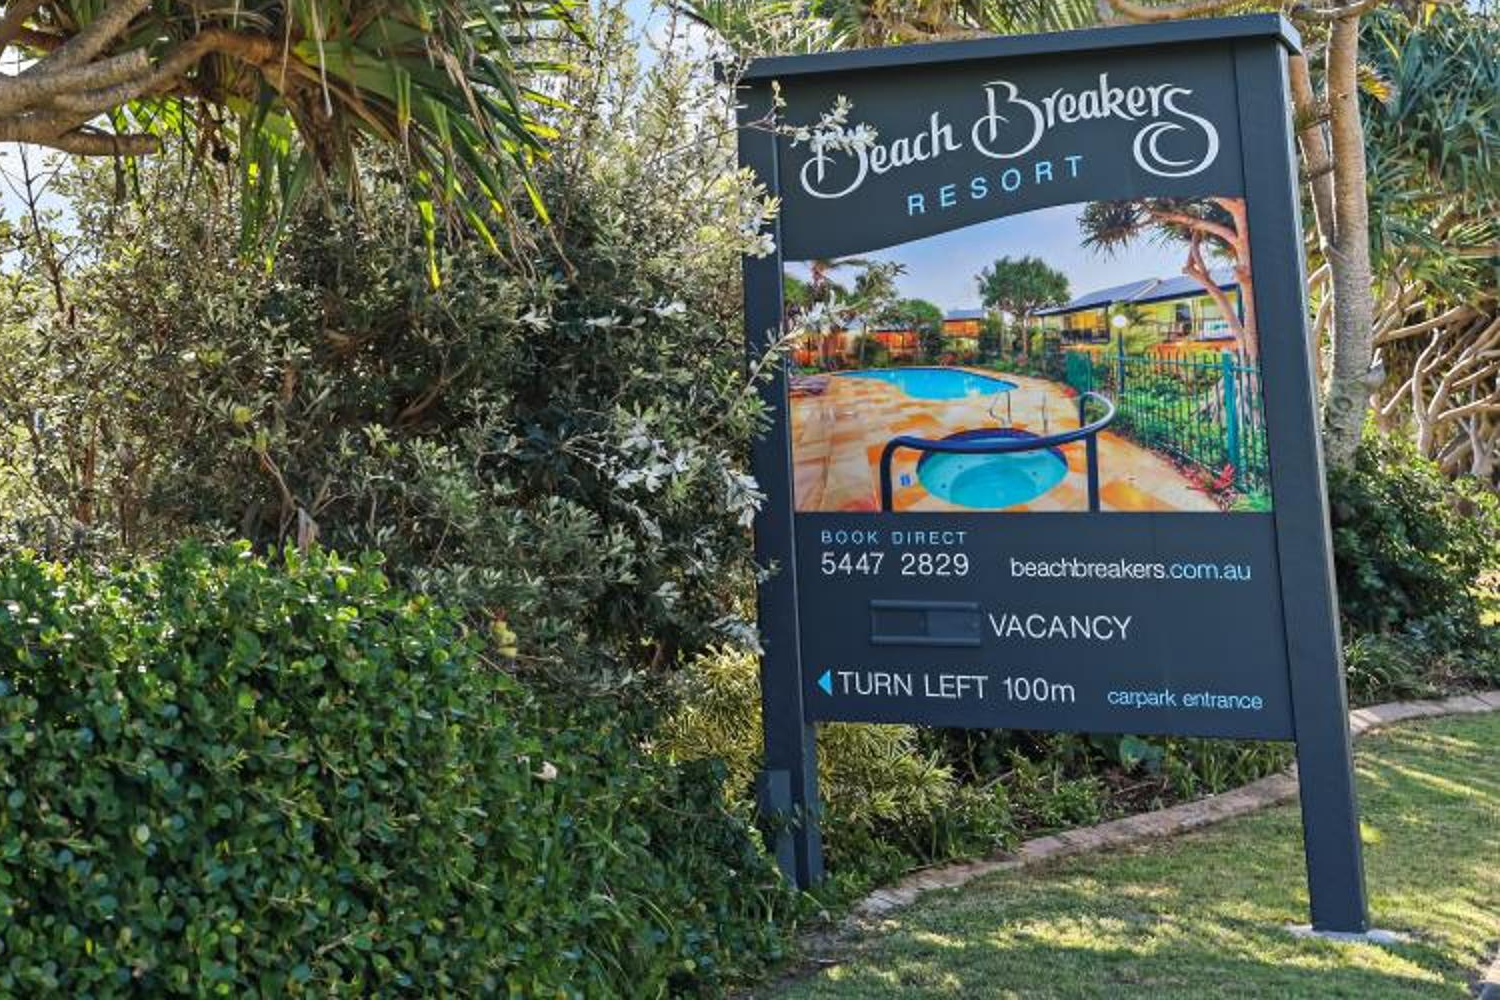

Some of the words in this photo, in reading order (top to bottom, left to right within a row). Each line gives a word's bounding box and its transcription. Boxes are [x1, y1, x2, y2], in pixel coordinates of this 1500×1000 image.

[801, 110, 963, 199] Beach
[972, 73, 1219, 178] Breakers
[907, 154, 1084, 217] RESORT
[821, 530, 878, 545] BOOK
[892, 531, 966, 545] DIRECT
[821, 552, 885, 575] 5447
[901, 552, 969, 577] 2829
[1010, 557, 1251, 581] beachbreakers.com.au
[989, 613, 1132, 641] VACANCY
[837, 671, 913, 697] TURN
[924, 674, 989, 699] LEFT
[1003, 676, 1076, 703] 100m
[1107, 688, 1177, 709] carpark
[1182, 691, 1263, 711] entrance
